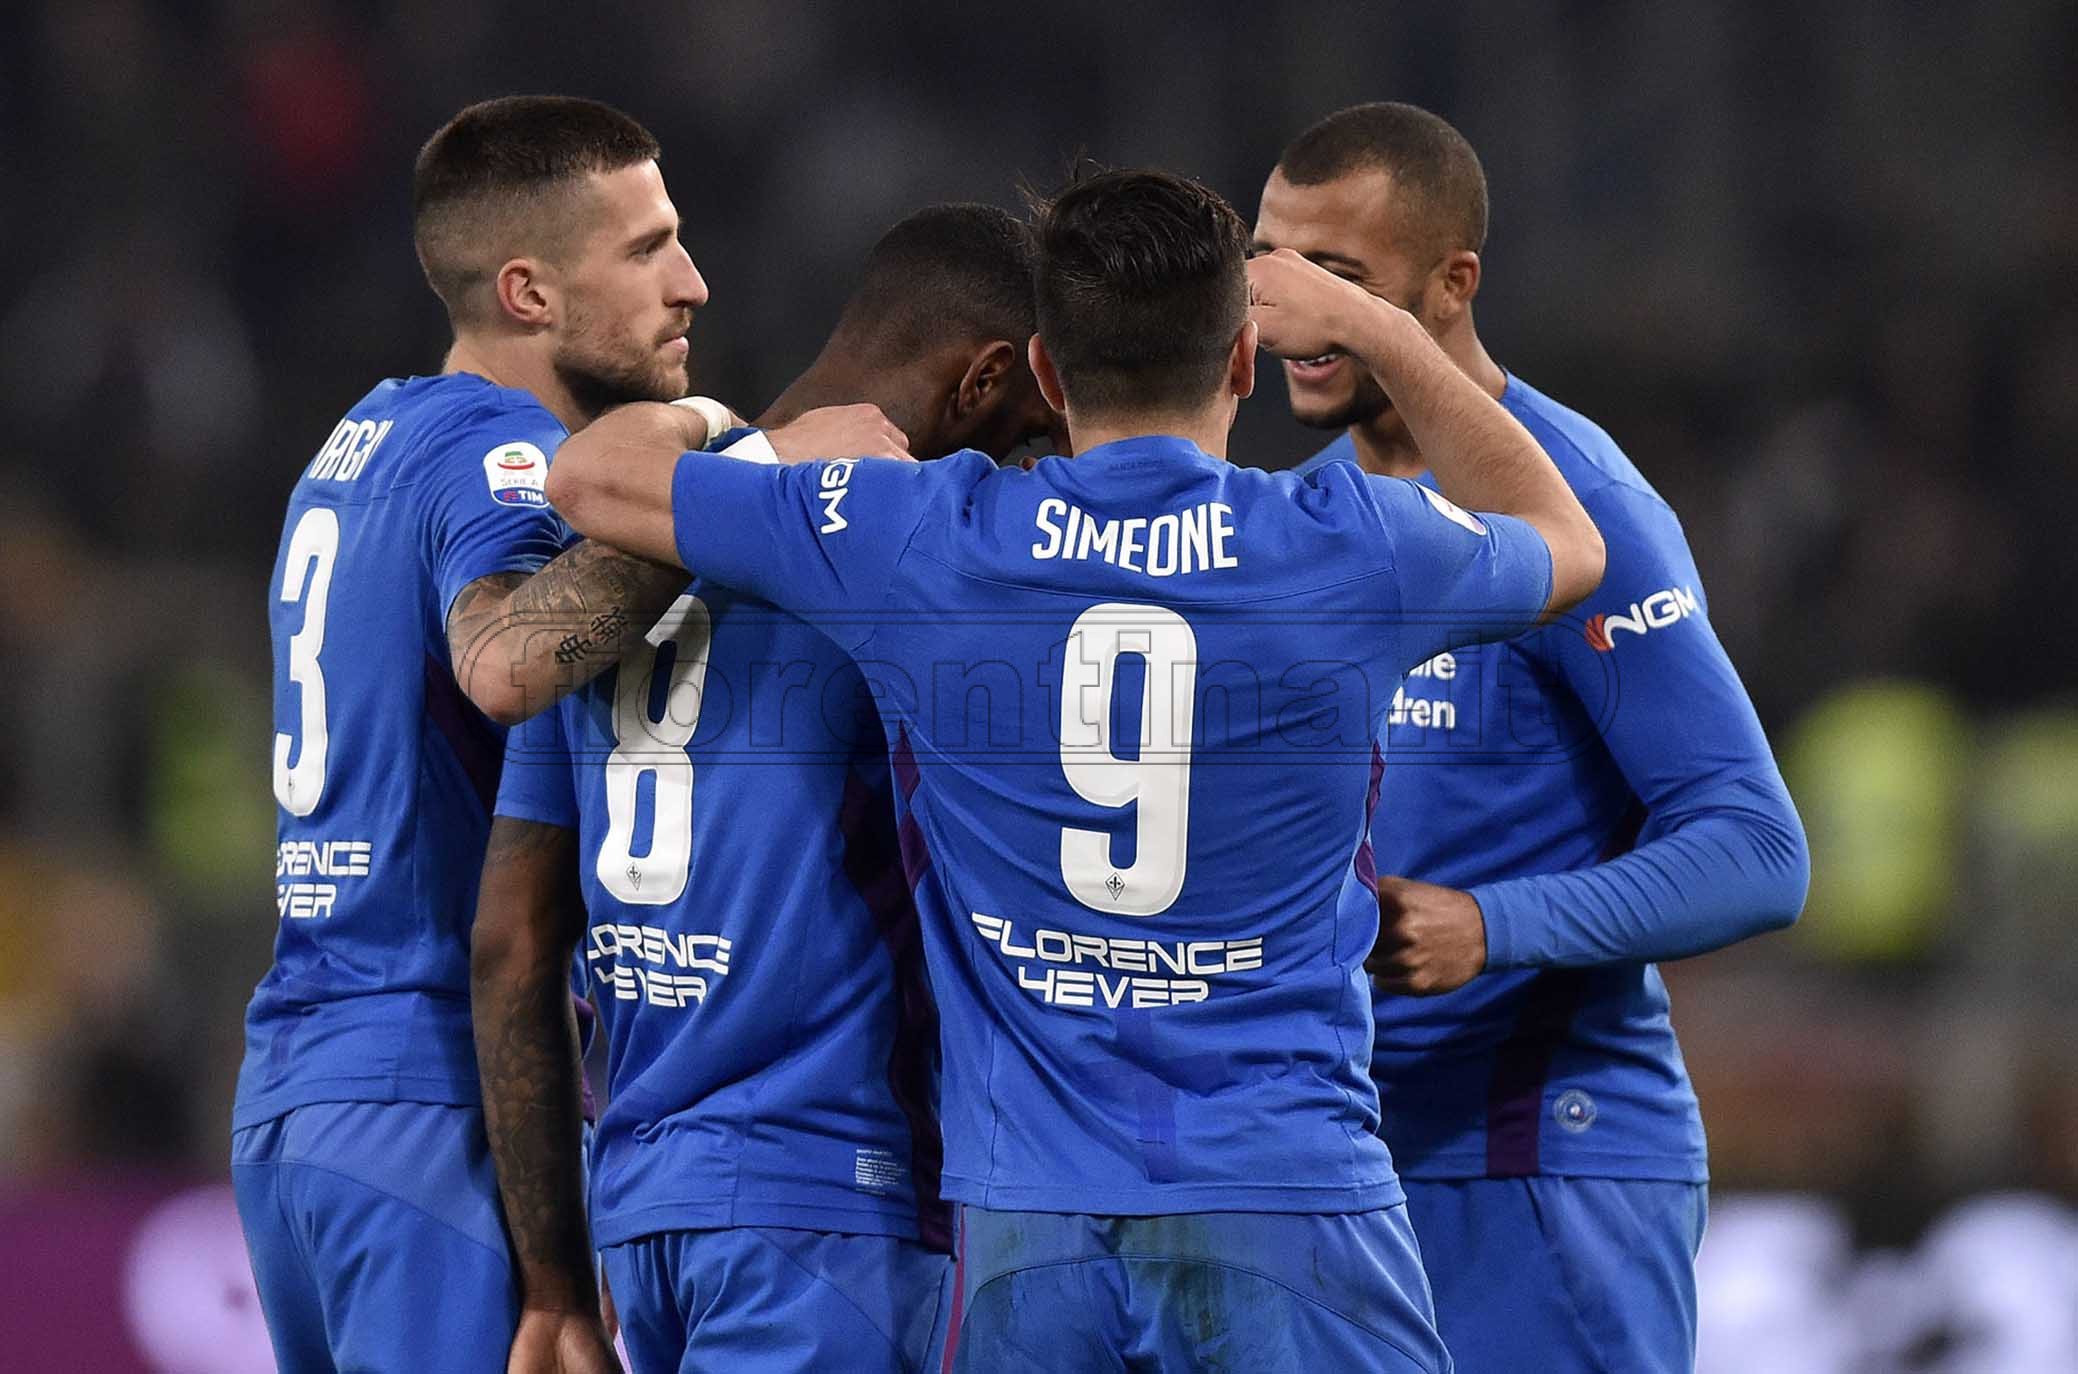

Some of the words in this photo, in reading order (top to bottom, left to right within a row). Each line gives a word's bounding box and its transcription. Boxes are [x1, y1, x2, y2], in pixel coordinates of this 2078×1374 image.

[517, 489, 545, 504] TIM
[818, 457, 859, 534] GM
[1032, 498, 1238, 577] SIMEONE
[1604, 585, 1699, 648] NGM
[272, 507, 339, 817] 3
[597, 594, 711, 905] 8
[1060, 602, 1197, 916] 9
[972, 911, 1262, 975] FLORENCE
[1018, 966, 1209, 1008] 4EVER
